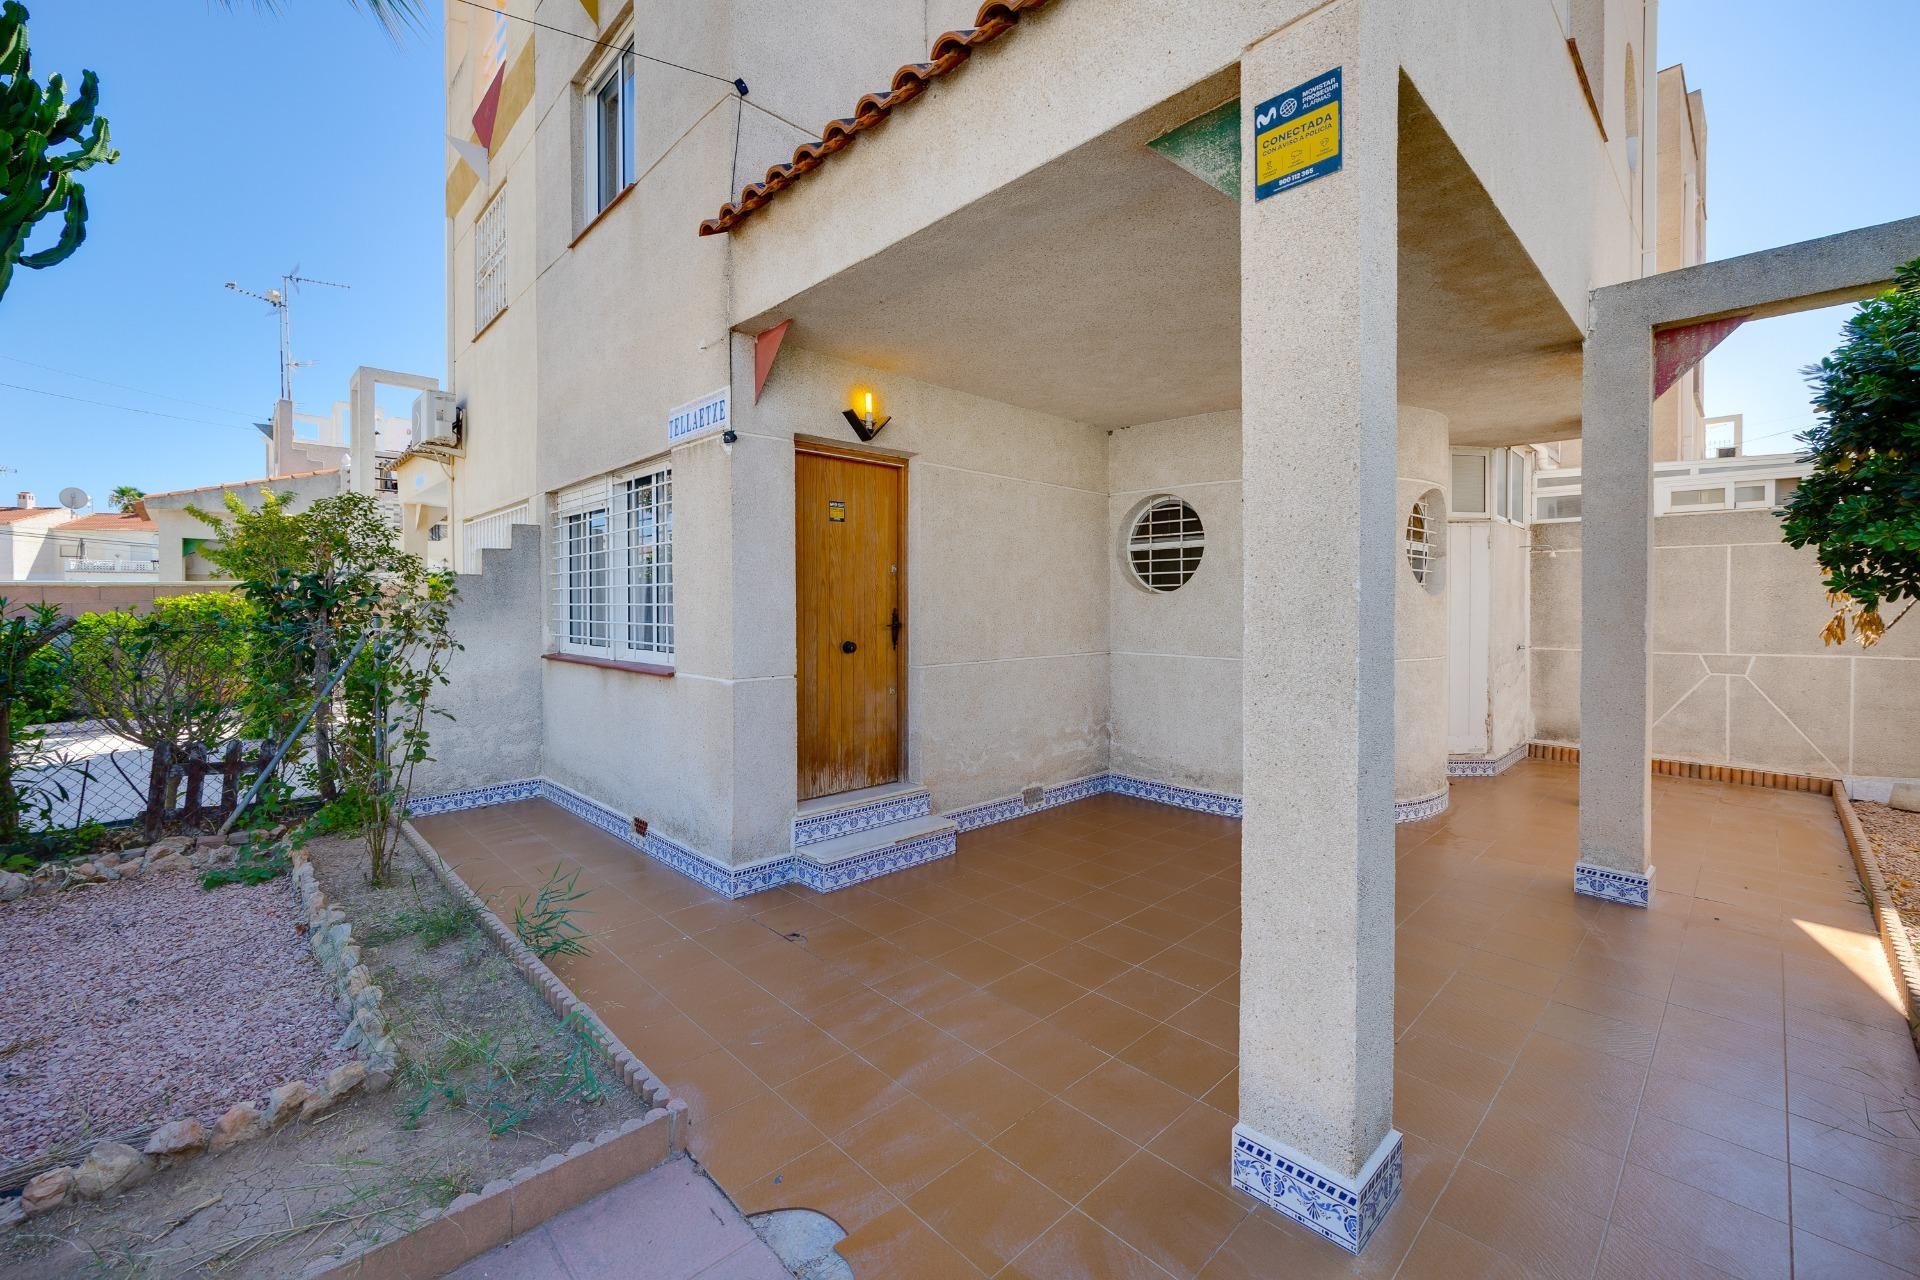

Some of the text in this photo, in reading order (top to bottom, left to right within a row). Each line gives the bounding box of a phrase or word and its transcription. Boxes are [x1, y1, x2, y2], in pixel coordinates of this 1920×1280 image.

[1302, 77, 1336, 97] MOVISTAR
[1302, 83, 1339, 103] PROSEGUR
[1302, 93, 1331, 109] ALARMAS
[1262, 113, 1333, 149] CONECTADA
[1262, 146, 1277, 157] CON
[1277, 137, 1299, 151] AVISO
[1291, 172, 1301, 182] 112
